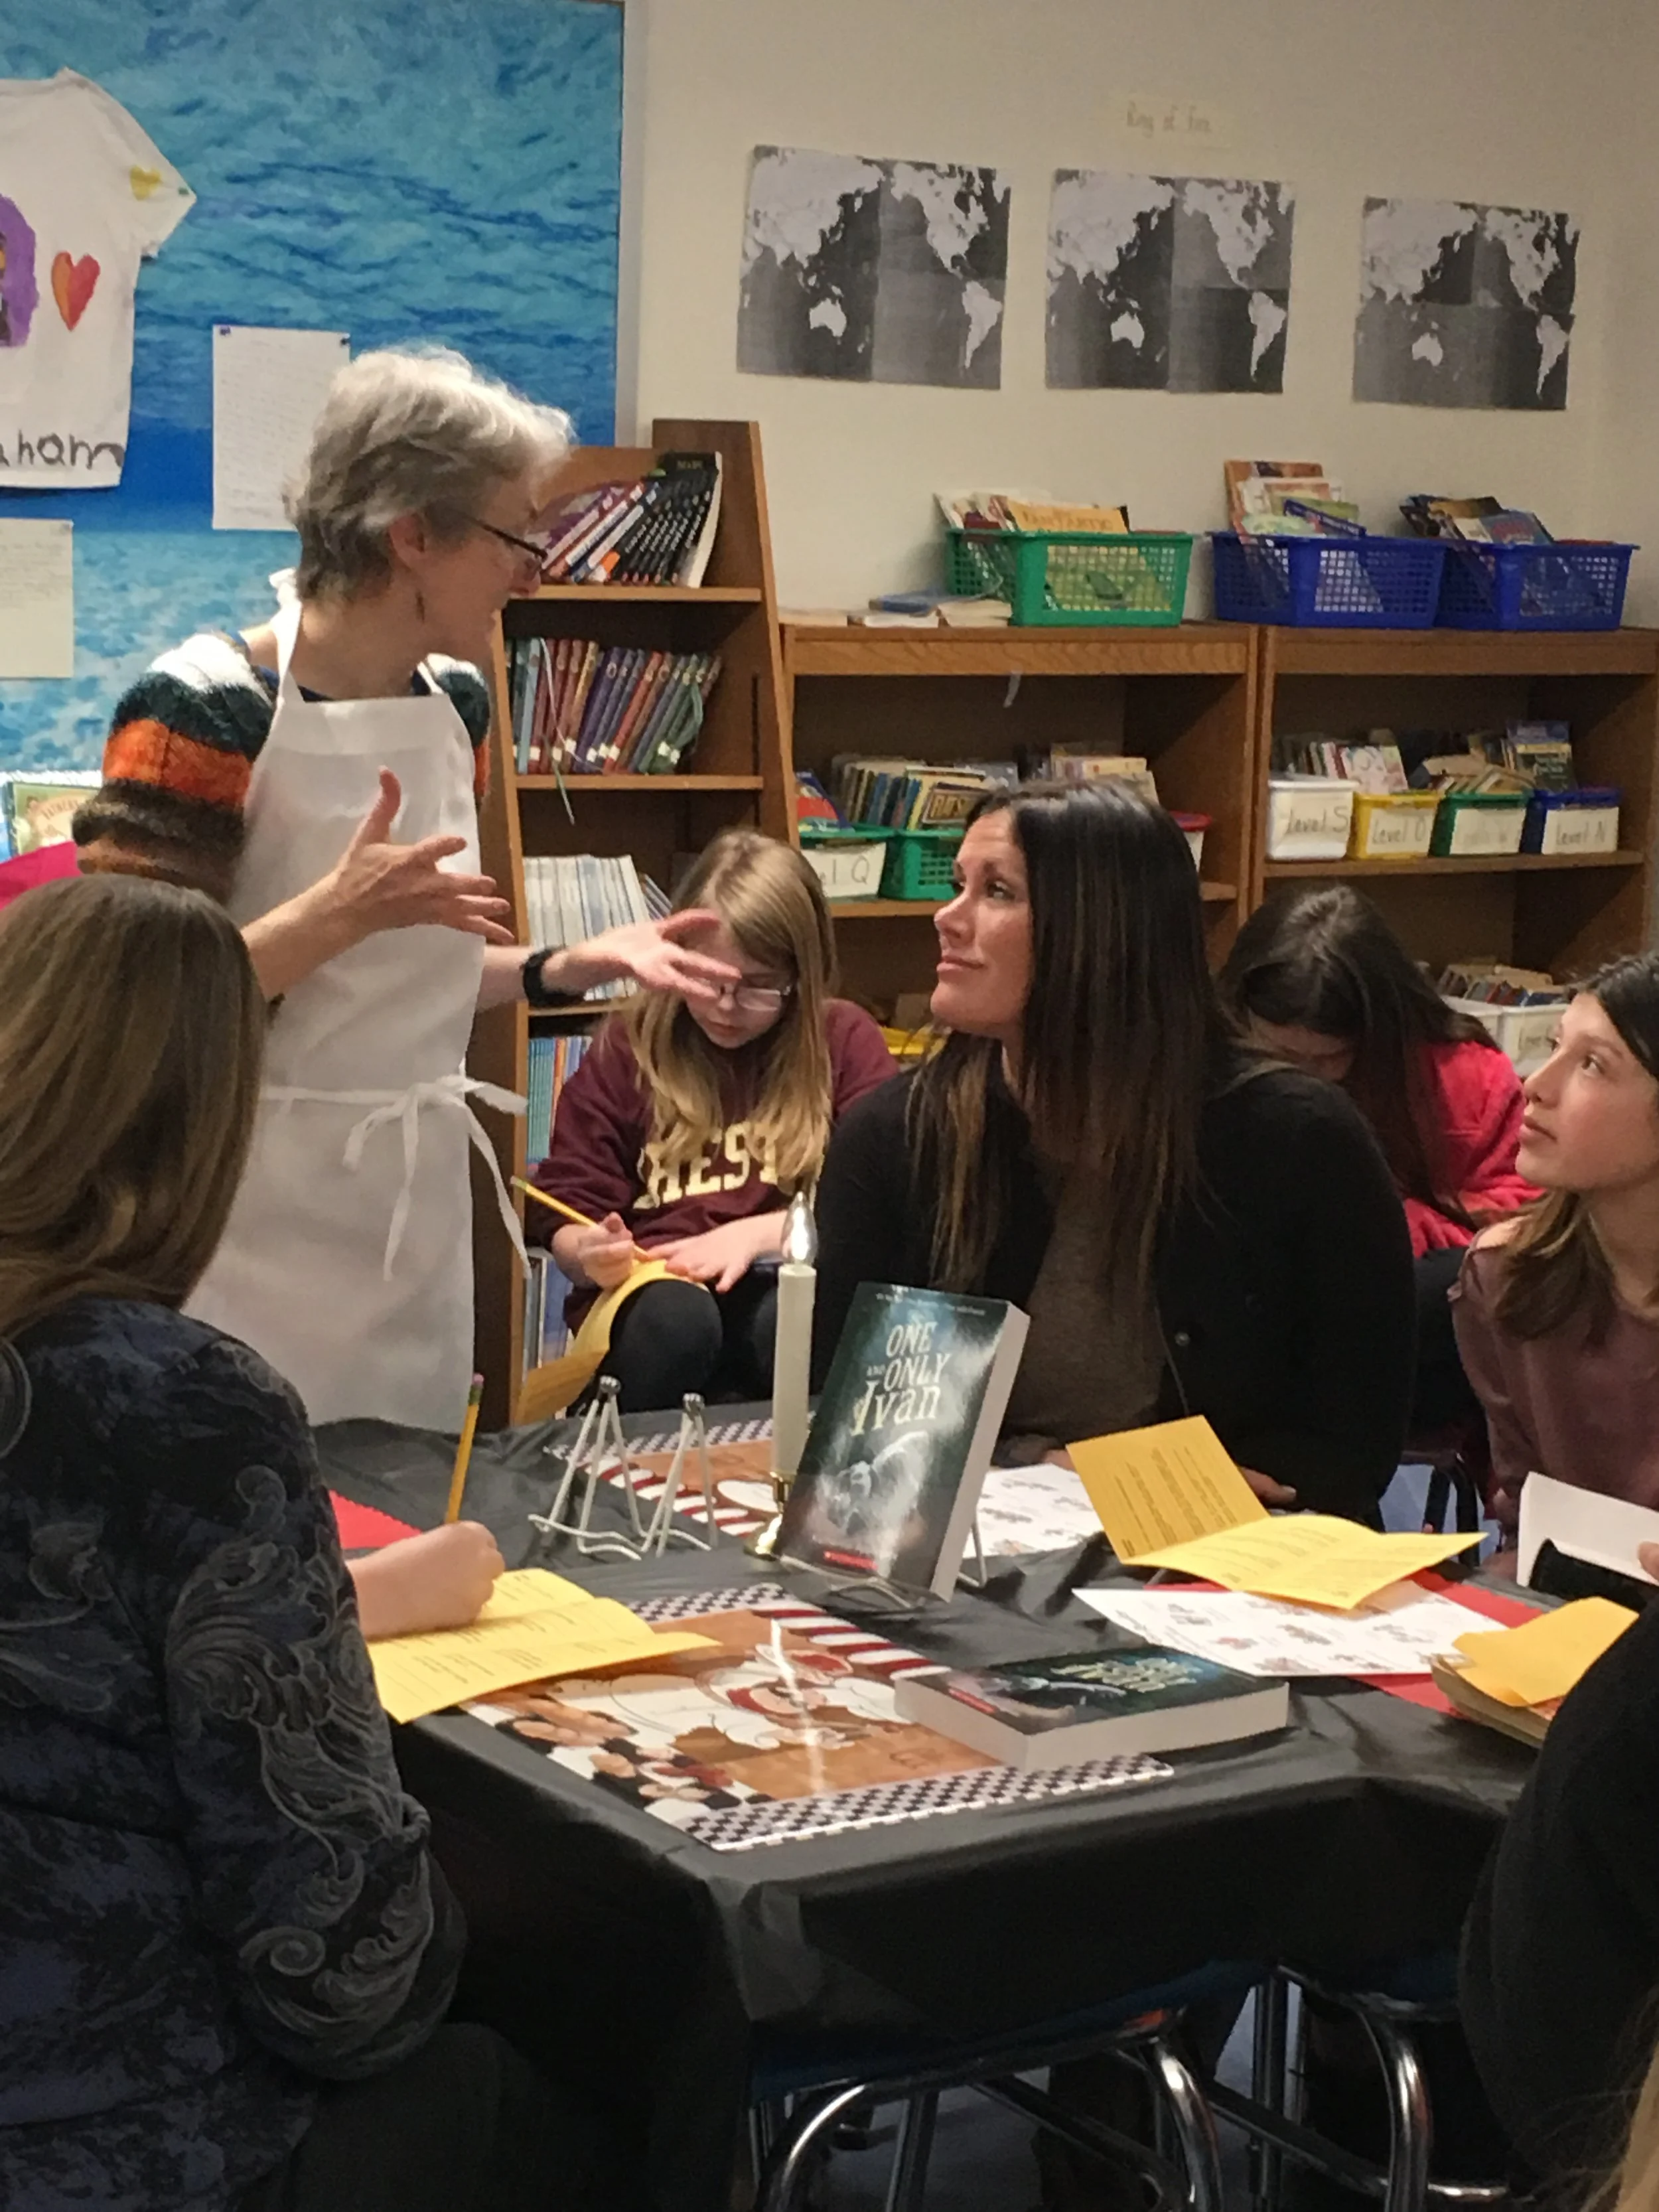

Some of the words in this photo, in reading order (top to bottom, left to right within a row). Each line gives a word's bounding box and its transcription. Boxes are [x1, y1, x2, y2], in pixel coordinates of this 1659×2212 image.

[1333, 805, 1349, 833] S
[851, 855, 870, 885] Q
[886, 1321, 938, 1359] ONE
[883, 1353, 952, 1392] ONLY
[849, 1380, 941, 1437] Ivan
